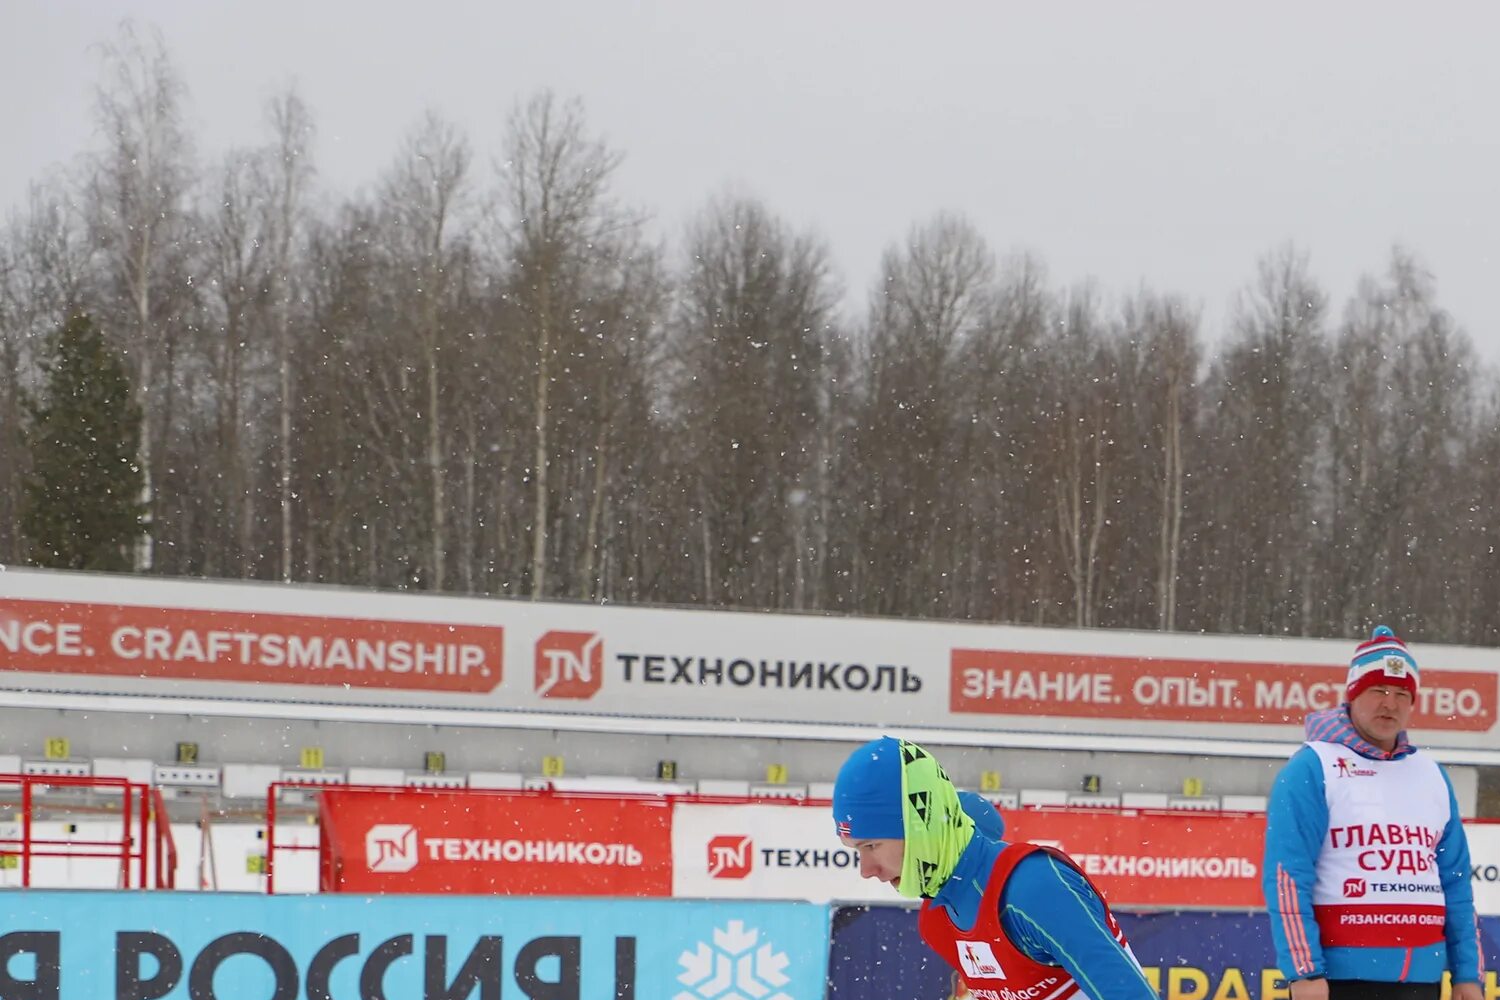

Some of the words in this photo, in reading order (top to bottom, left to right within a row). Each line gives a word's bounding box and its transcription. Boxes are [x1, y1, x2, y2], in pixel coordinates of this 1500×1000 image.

[111, 626, 491, 677] CRAFTSMANSHIP.
[617, 653, 922, 693] ТЕХНОНИКОЛЬ
[963, 667, 1121, 704] ЗНАНИЕ.
[1134, 675, 1243, 709] ОПЫТ.
[1255, 682, 1488, 718] МАСТТВО.
[424, 837, 642, 866] ТЕХНОНИКОЛЬ
[1071, 854, 1257, 878] ТЕХНОНИКОЛЬ
[1340, 914, 1417, 925] РЯЗАНСКАЯ
